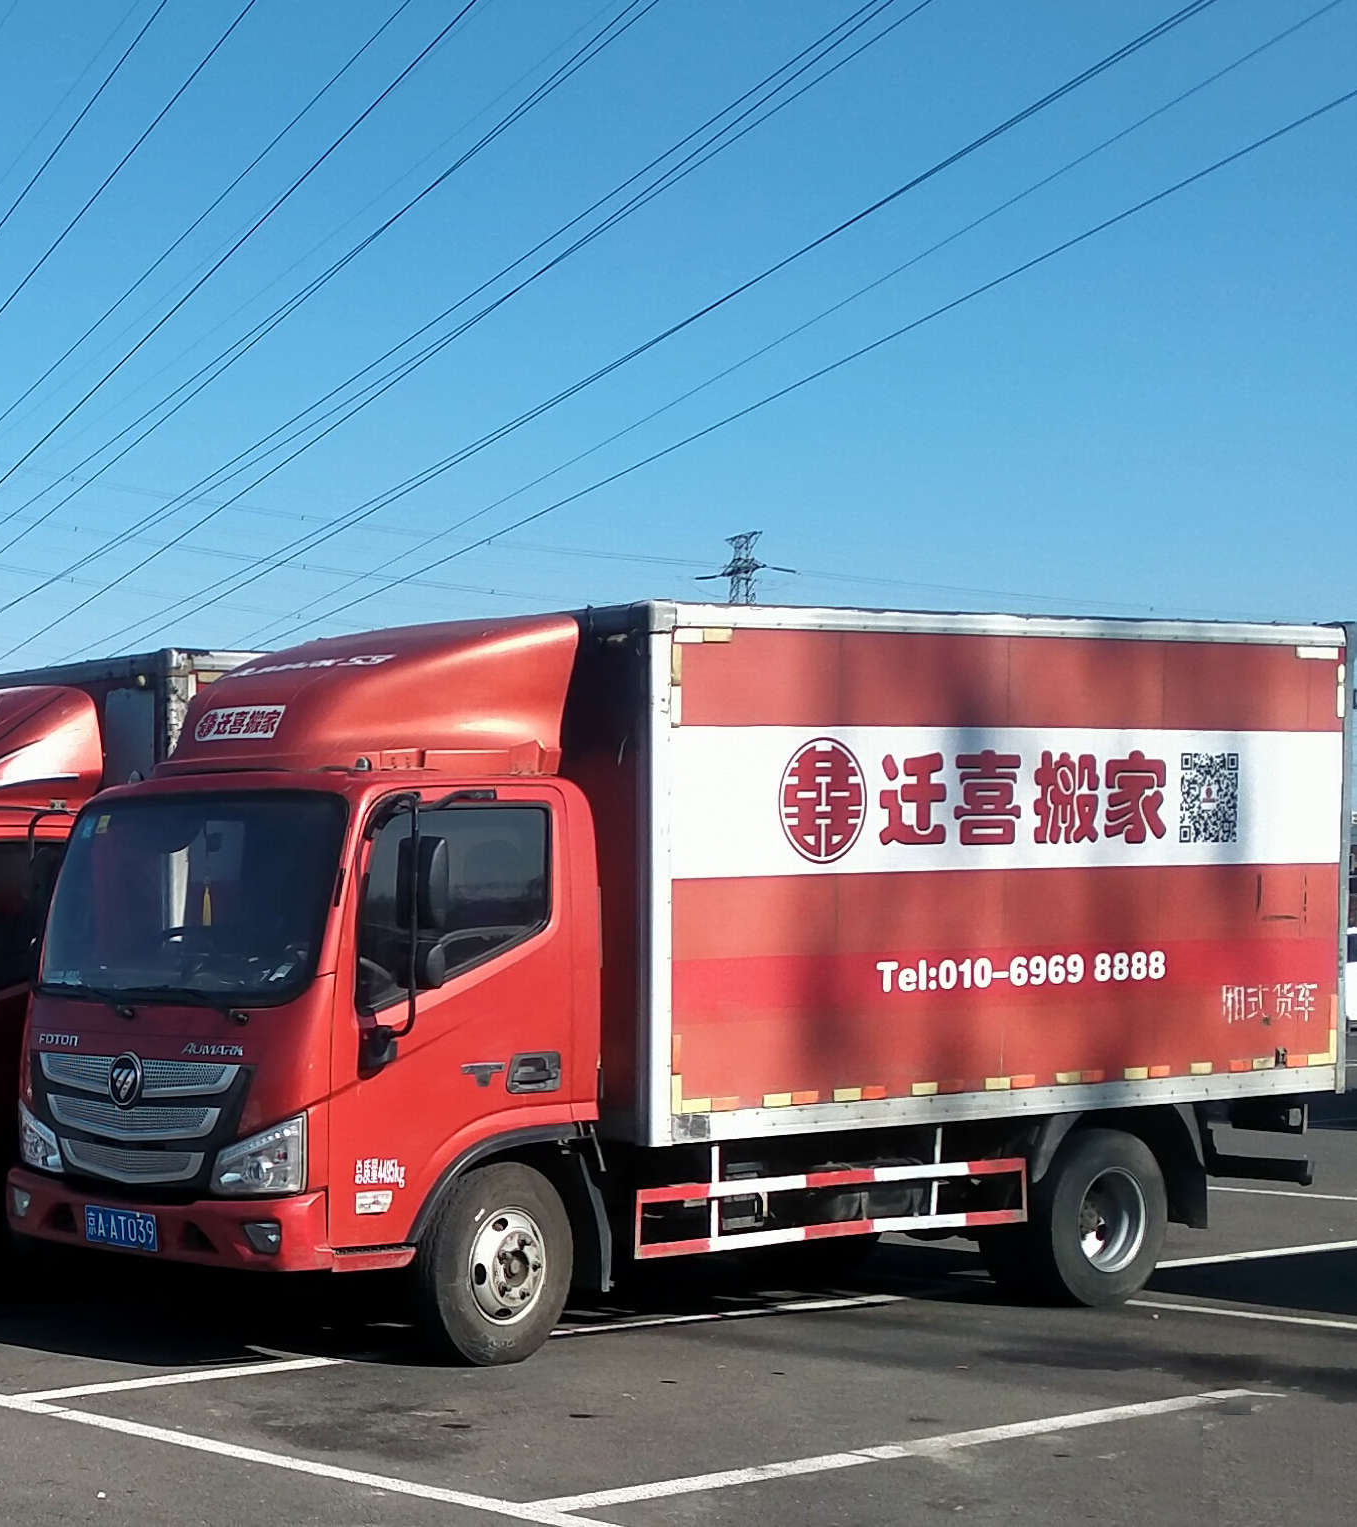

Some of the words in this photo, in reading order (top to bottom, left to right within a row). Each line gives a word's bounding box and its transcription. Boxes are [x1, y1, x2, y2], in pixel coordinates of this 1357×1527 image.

[213, 709, 280, 735] 迁喜搬家
[880, 750, 1167, 846] 迁喜搬家
[1094, 950, 1166, 982] 8888
[39, 1034, 79, 1047] FOTON
